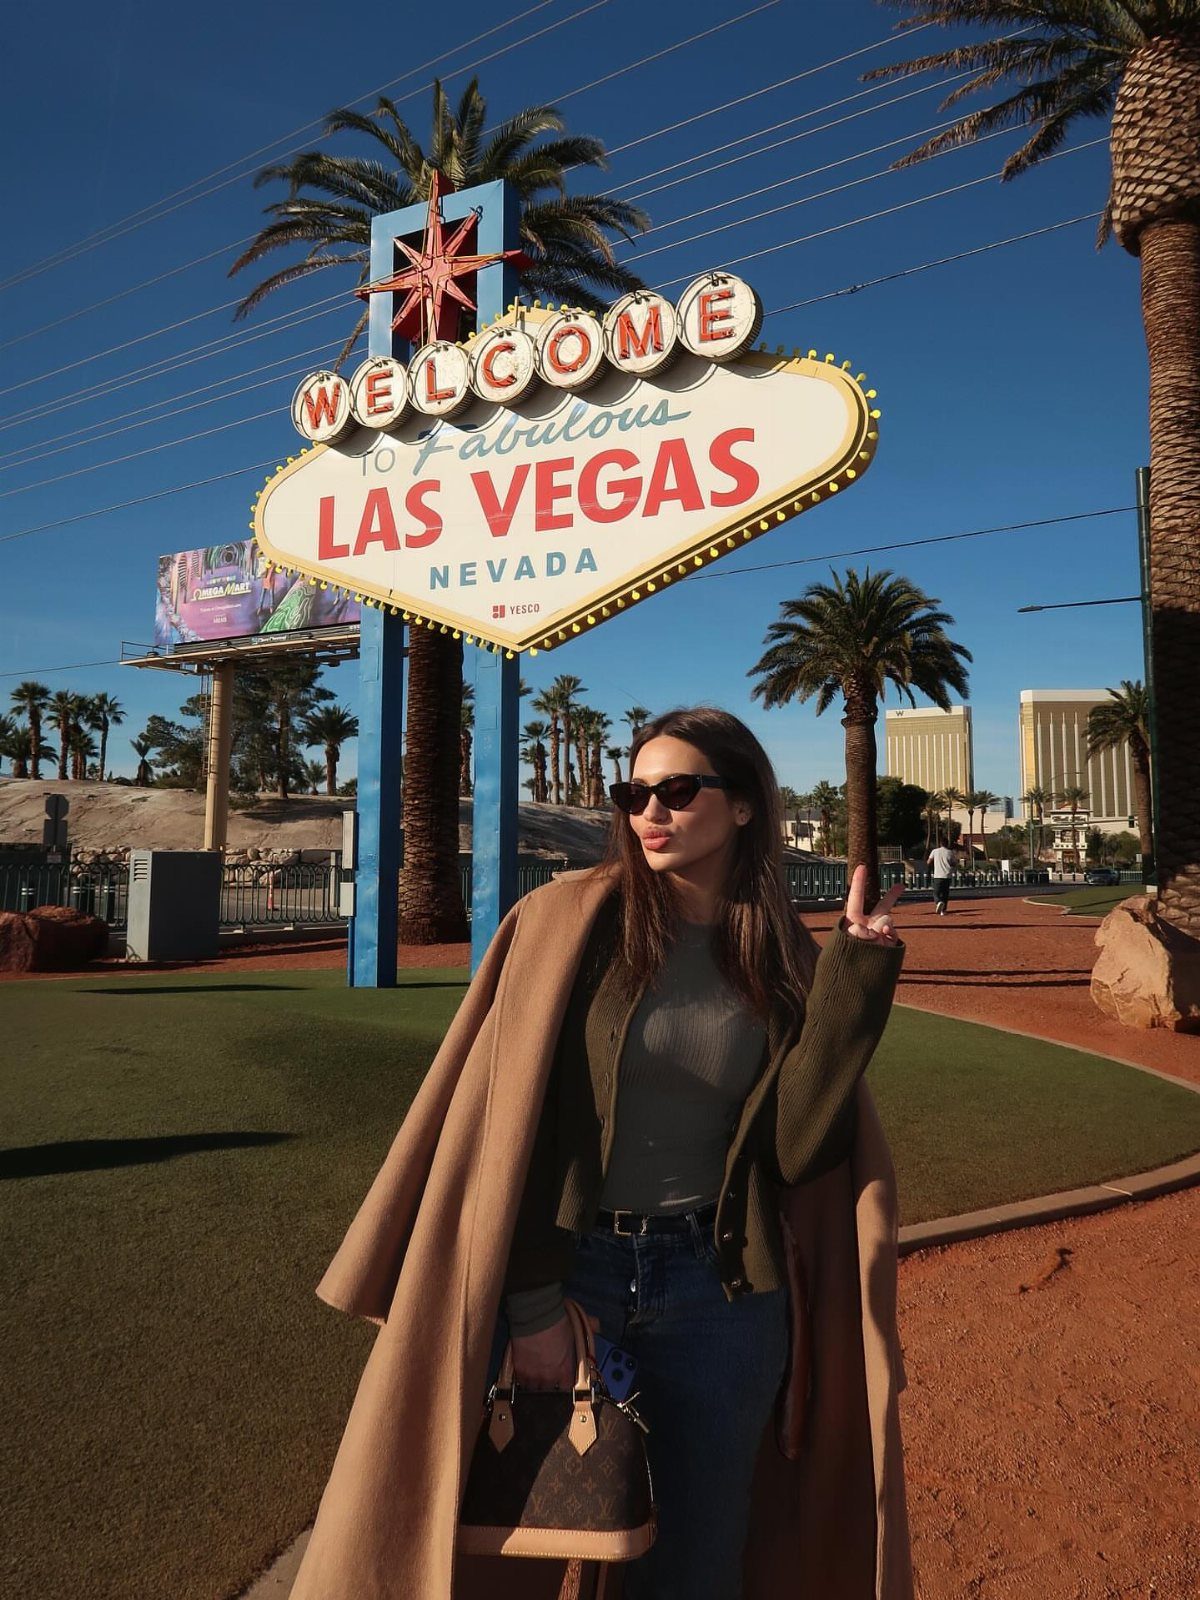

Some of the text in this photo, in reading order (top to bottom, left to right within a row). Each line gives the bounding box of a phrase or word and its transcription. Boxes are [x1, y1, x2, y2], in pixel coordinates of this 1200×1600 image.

[303, 285, 735, 431] WELCOME
[411, 398, 692, 476] Fabulous
[318, 427, 760, 561] LAS VEGAS
[429, 547, 598, 590] NEVADA
[510, 603, 540, 615] YESCO
